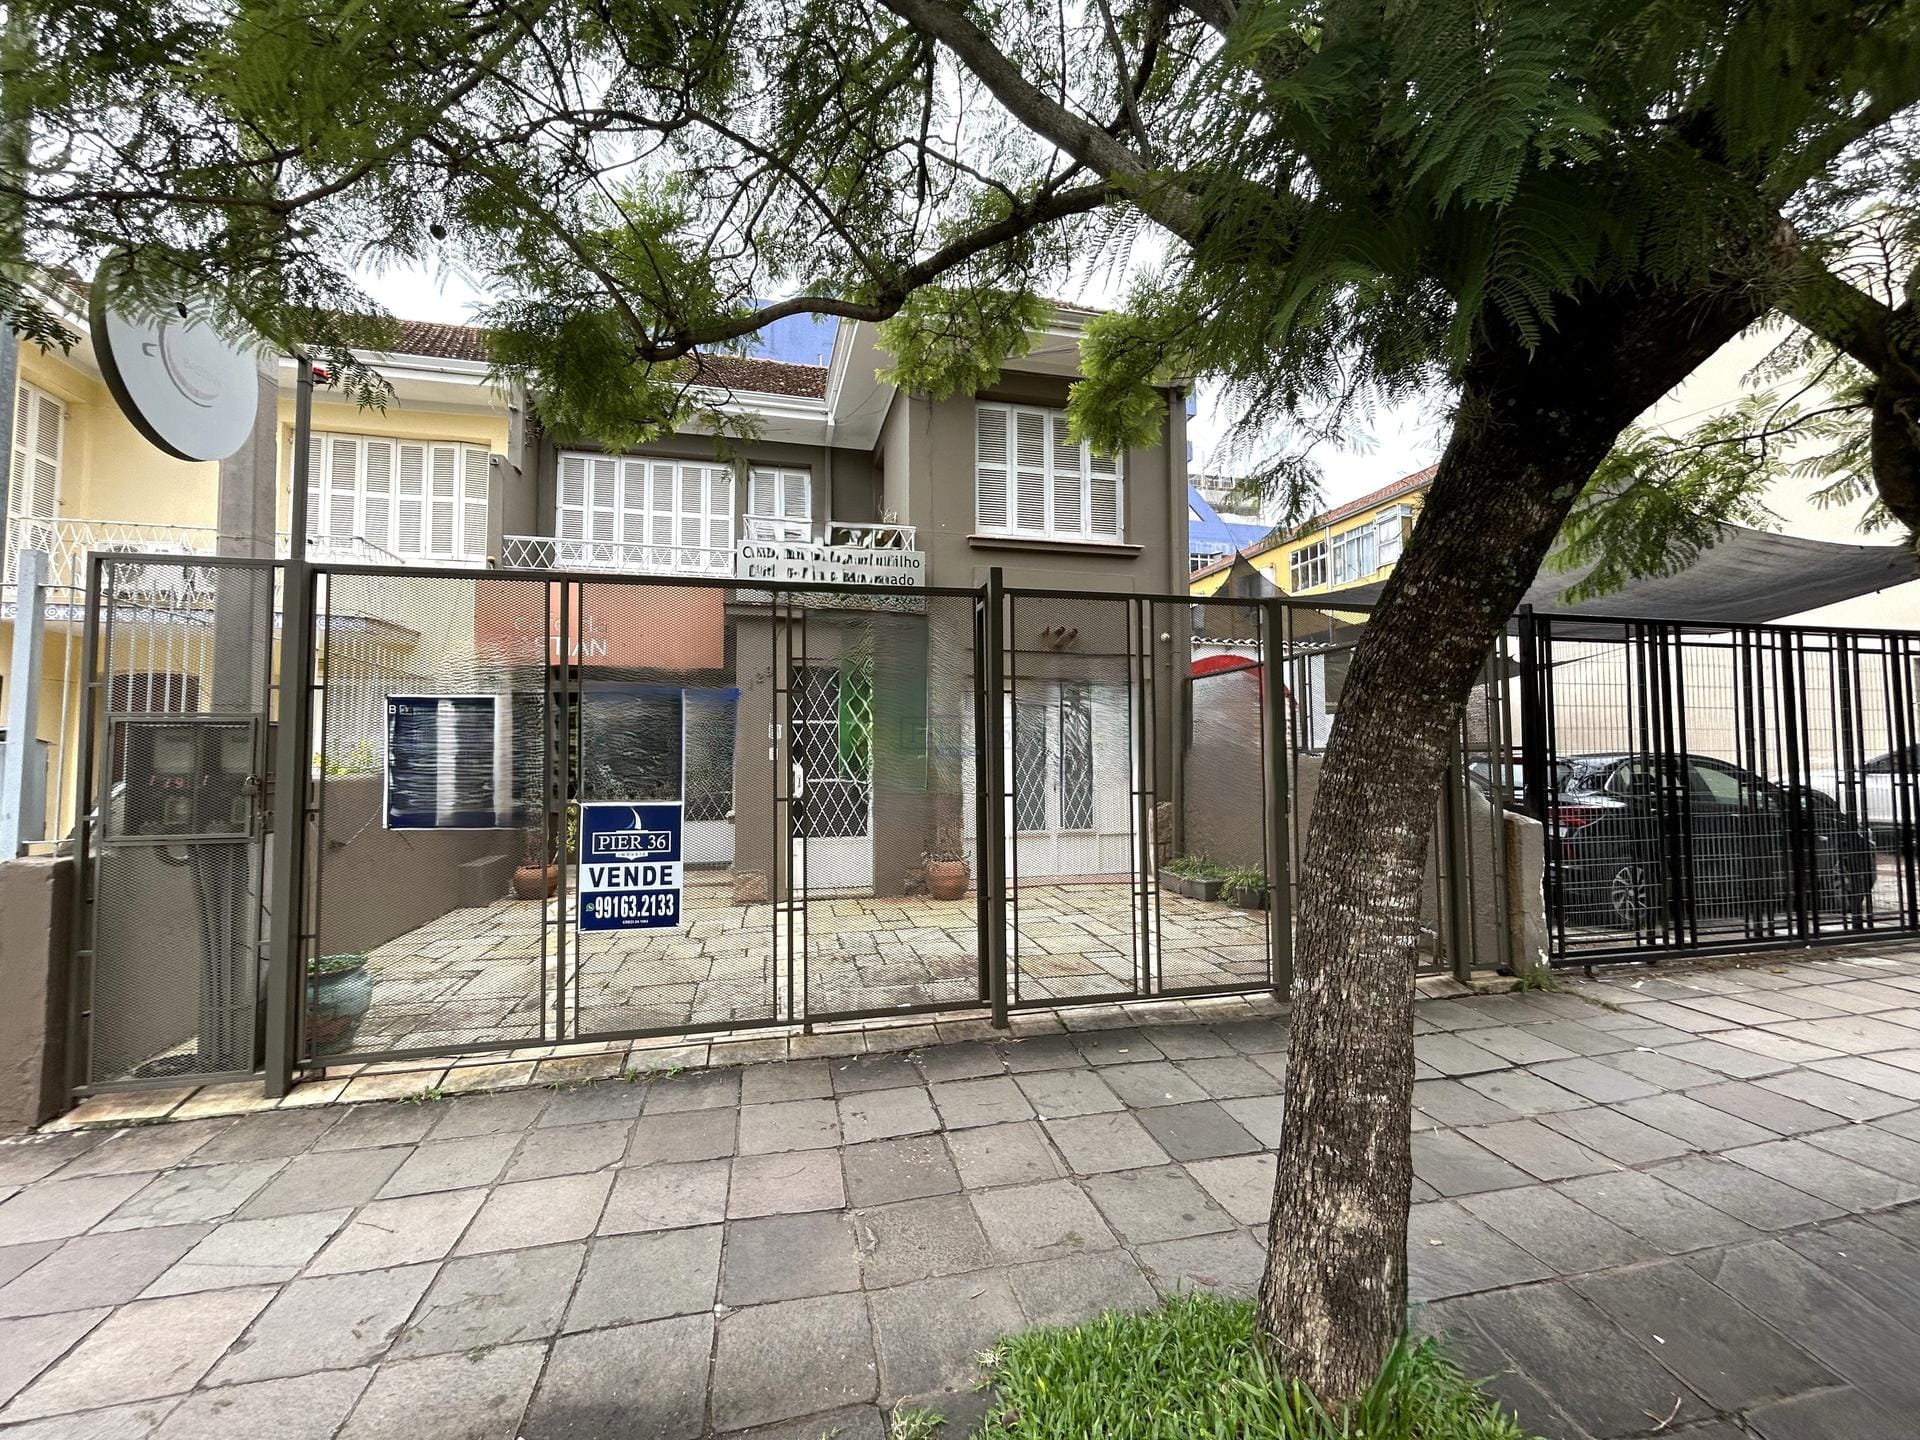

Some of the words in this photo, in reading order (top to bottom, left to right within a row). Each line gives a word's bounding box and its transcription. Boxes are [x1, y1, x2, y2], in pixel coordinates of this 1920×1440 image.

[598, 835, 643, 850] PIER
[647, 834, 666, 849] 36
[589, 865, 673, 888] VENDE
[595, 894, 674, 918] 99163.2133
